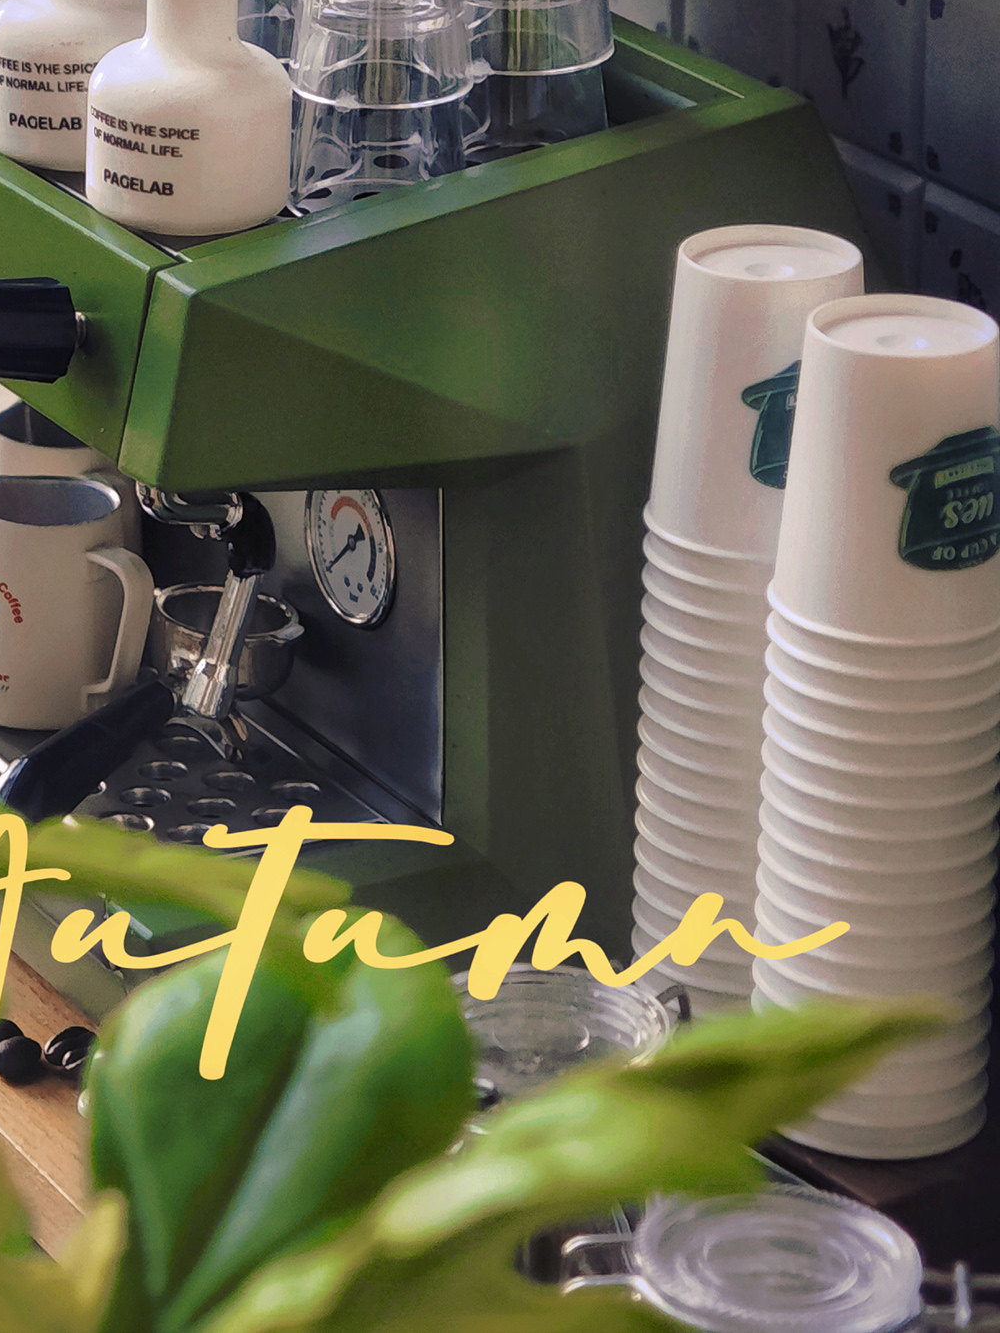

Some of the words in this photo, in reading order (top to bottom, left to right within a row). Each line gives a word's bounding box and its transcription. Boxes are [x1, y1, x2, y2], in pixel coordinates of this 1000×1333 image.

[21, 62, 32, 73] IS
[34, 62, 60, 75] YHE
[6, 76, 55, 93] NORMAL
[57, 81, 88, 93] LIFE.
[9, 112, 83, 131] PAGELAB
[90, 105, 117, 128] COFFEE
[118, 117, 128, 131] IS
[130, 121, 157, 137] YHE
[159, 127, 200, 141] SPICE
[94, 126, 103, 140] OF
[103, 133, 148, 155] NORMAL
[151, 144, 183, 158] LIFE.
[103, 168, 174, 197] PAGELAB
